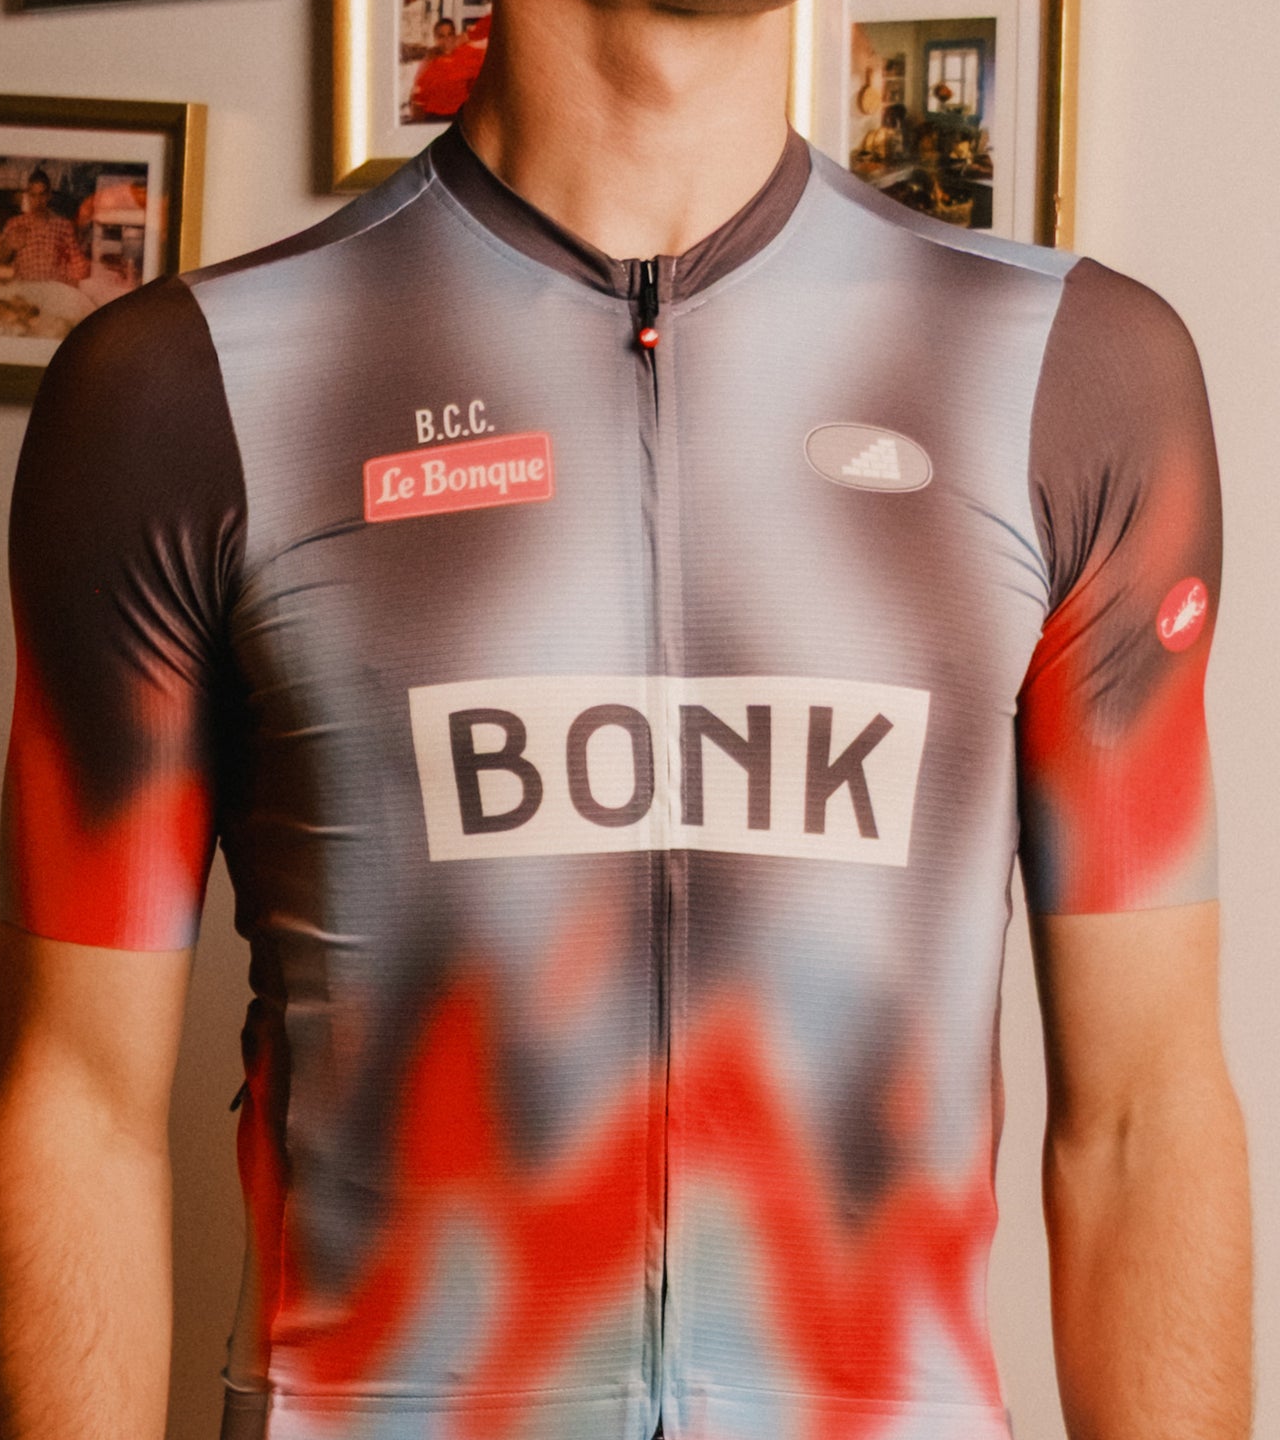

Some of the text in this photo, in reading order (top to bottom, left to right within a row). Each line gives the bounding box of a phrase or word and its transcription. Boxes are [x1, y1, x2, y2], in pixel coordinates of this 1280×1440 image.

[415, 399, 495, 443] B.C.C.
[375, 458, 545, 504] Le Bonque
[448, 703, 895, 841] BONK
